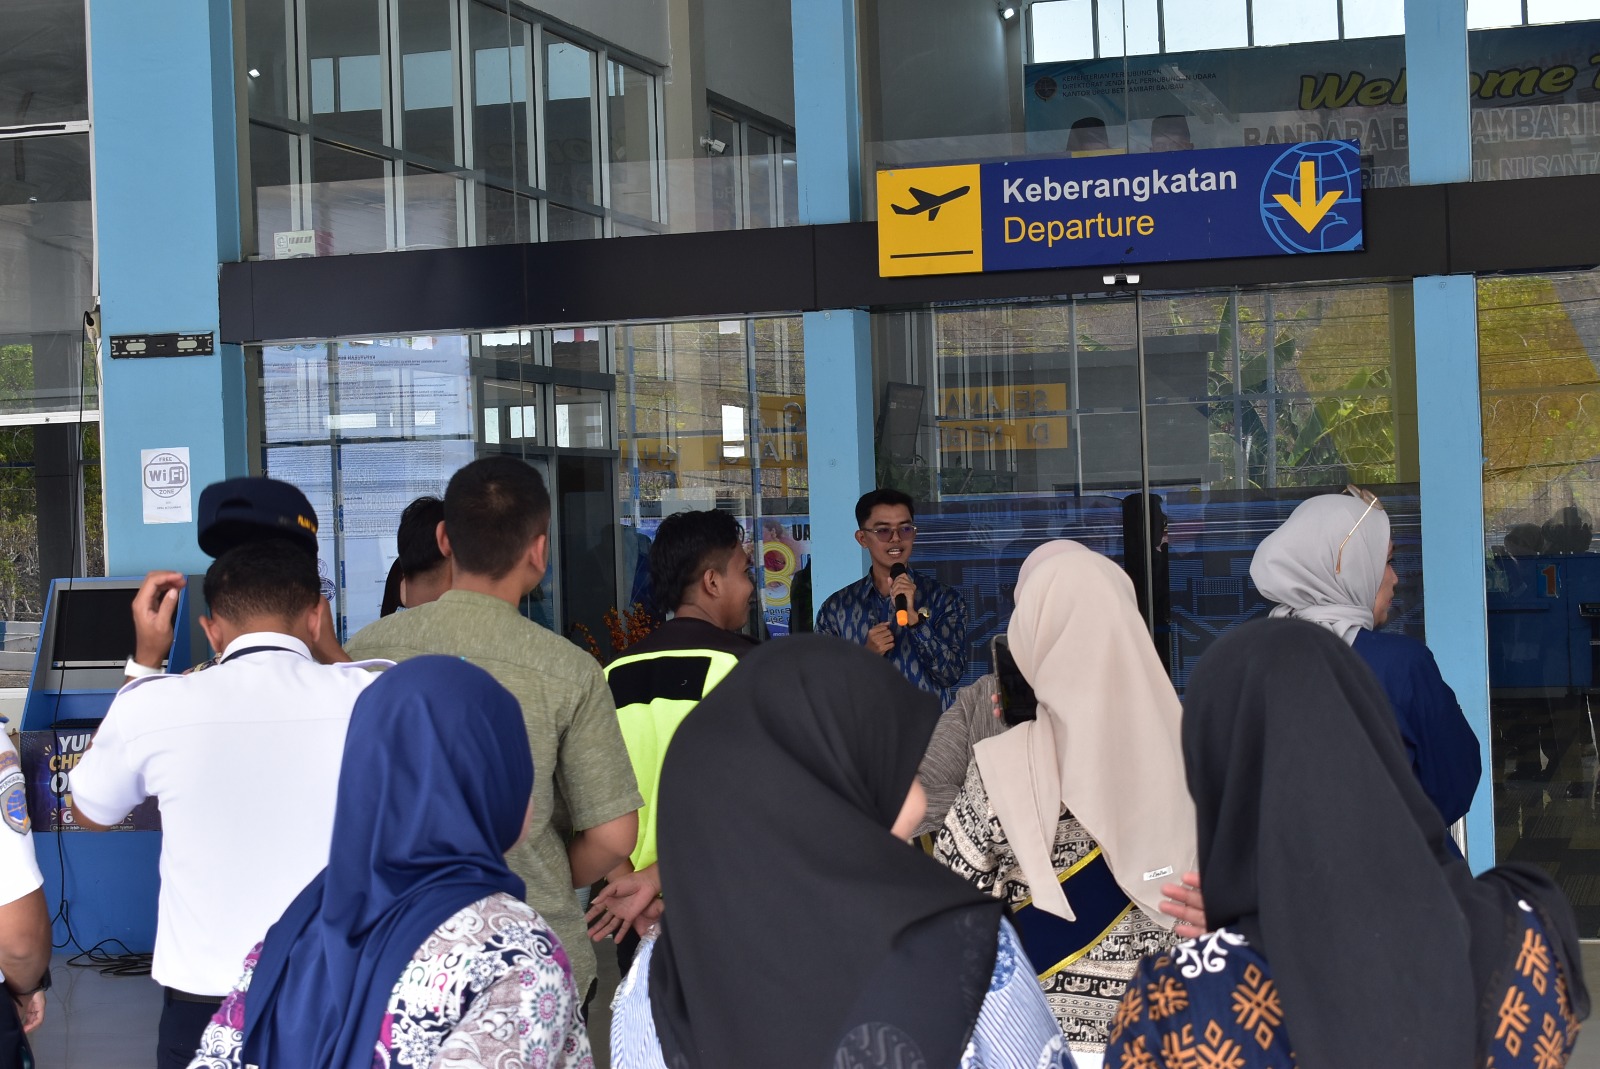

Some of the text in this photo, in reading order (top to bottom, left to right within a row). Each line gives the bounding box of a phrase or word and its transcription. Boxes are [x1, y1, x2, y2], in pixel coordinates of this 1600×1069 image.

[1062, 69, 1162, 82] KEMENTERIAN PERUBUNGAN
[1062, 82, 1103, 90] DIREKTORAT
[1193, 73, 1217, 81] UDARA
[1062, 90, 1091, 98] KANTOR
[1111, 85, 1155, 94] BETAMBARI
[1298, 64, 1578, 110] Welme
[1003, 168, 1237, 204] Keberangkatan
[1004, 212, 1154, 247] Departure
[1541, 563, 1557, 597] 1
